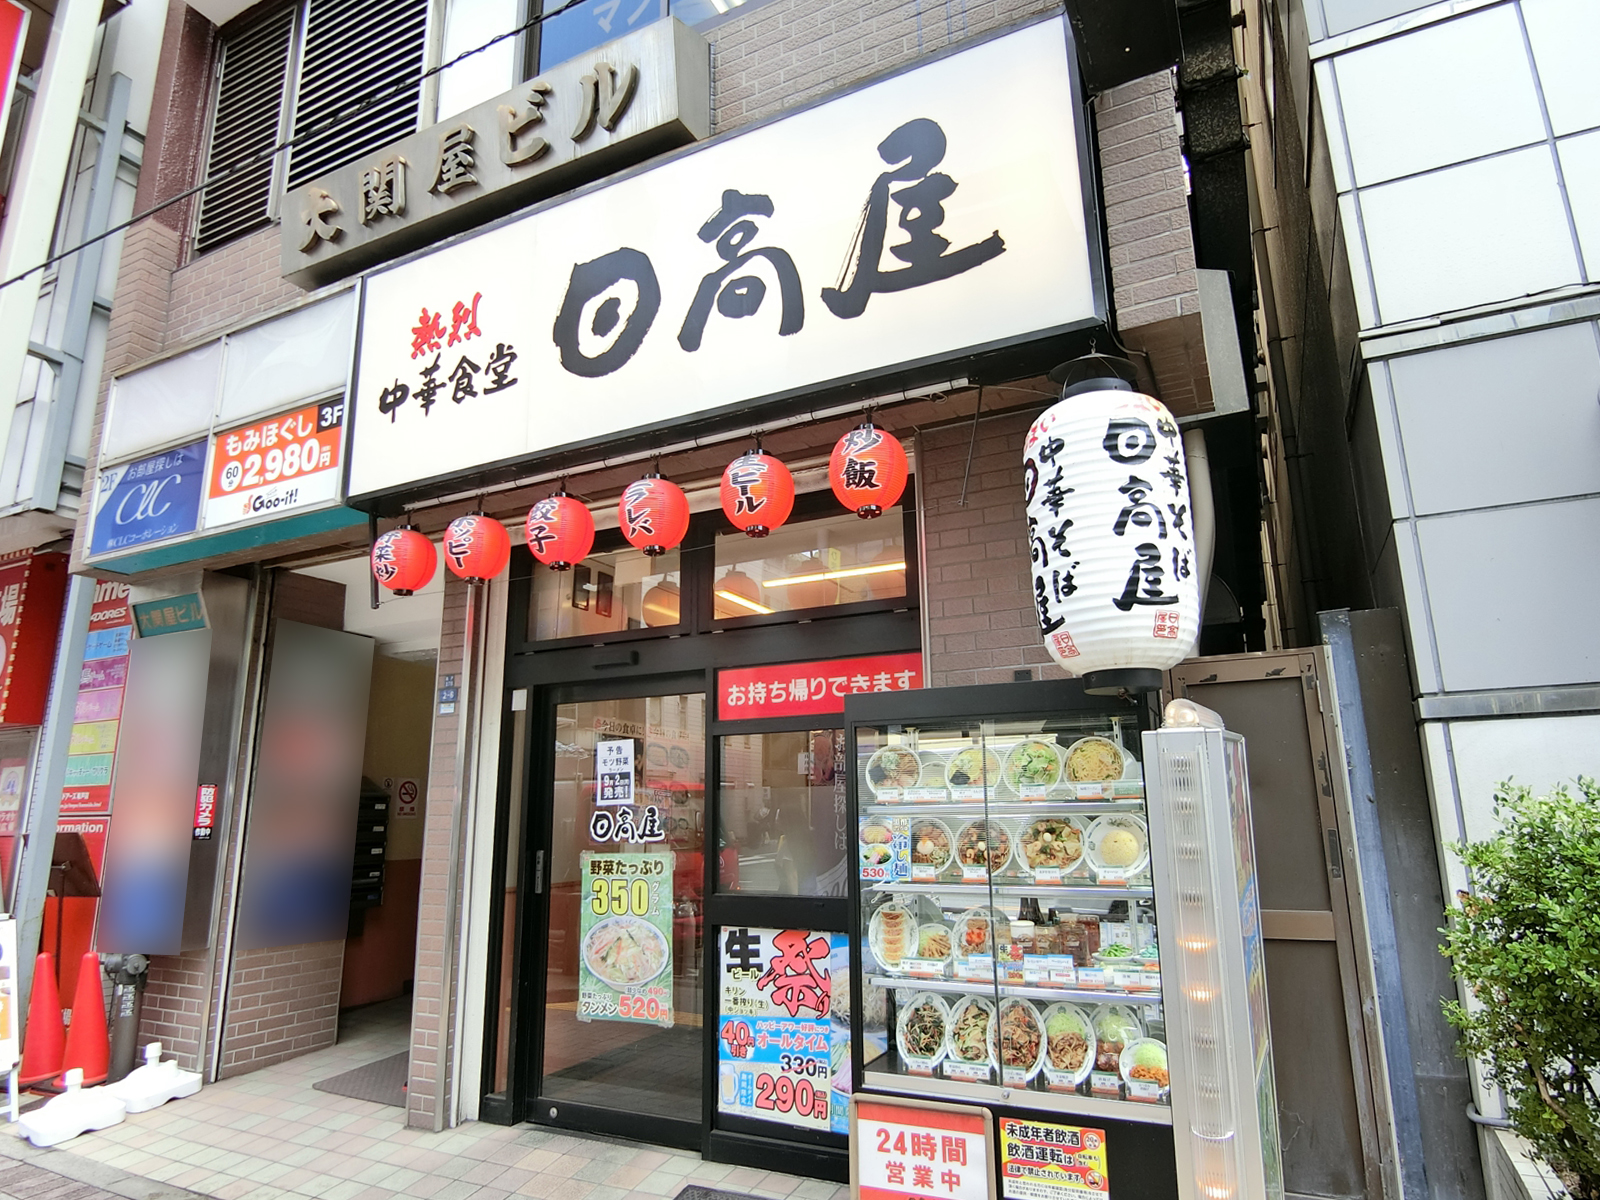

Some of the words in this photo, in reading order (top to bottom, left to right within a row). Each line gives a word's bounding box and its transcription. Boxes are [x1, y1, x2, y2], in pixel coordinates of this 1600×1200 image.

[300, 62, 638, 253] 大関屋ビル
[553, 118, 1006, 378] 日高屋
[411, 293, 482, 359] 熱烈
[378, 343, 519, 425] 中華食堂
[320, 405, 344, 427] 3F
[226, 415, 313, 456] もみほぐし
[127, 453, 184, 480] お部屋探しは
[226, 466, 239, 479] 60
[242, 438, 331, 487] 2,980円
[840, 428, 883, 490] 炒飯
[101, 472, 117, 493] 2F
[727, 455, 768, 516] 生ビール
[1157, 417, 1192, 582] 中華そば
[529, 498, 559, 554] 餃子
[1039, 436, 1080, 603] 中華そば
[1103, 418, 1179, 611] 日高屋
[448, 515, 478, 569] ホッピー
[1, 583, 20, 626] 場
[139, 602, 206, 631] 大関屋ビル
[727, 669, 916, 707] お持ち帰りできます
[602, 757, 629, 766] モツ野菜
[607, 746, 622, 755] 予告
[199, 788, 215, 826] 防犯カメラ
[591, 806, 665, 843] 日高屋
[590, 860, 664, 875] 野菜たっぷり
[893, 834, 907, 876] 冷し麺
[591, 878, 650, 916] 350
[651, 881, 660, 916] グラム
[725, 929, 763, 972] 生
[725, 987, 746, 996] キリン
[732, 967, 760, 979] ビール
[582, 1001, 617, 1015] タンメン
[721, 1020, 755, 1048] 40円
[756, 1021, 829, 1035] ハッピーアワー好評につき
[757, 1032, 828, 1052] オールタイム
[731, 1044, 747, 1059] 引き
[876, 1128, 967, 1167] 24時間
[1006, 1123, 1080, 1146] 未成年者飲酒
[1007, 1142, 1074, 1166] 飲酒運転は
[885, 1160, 961, 1193] 営業中
[1008, 1164, 1085, 1184] 法律で禁止されています。
